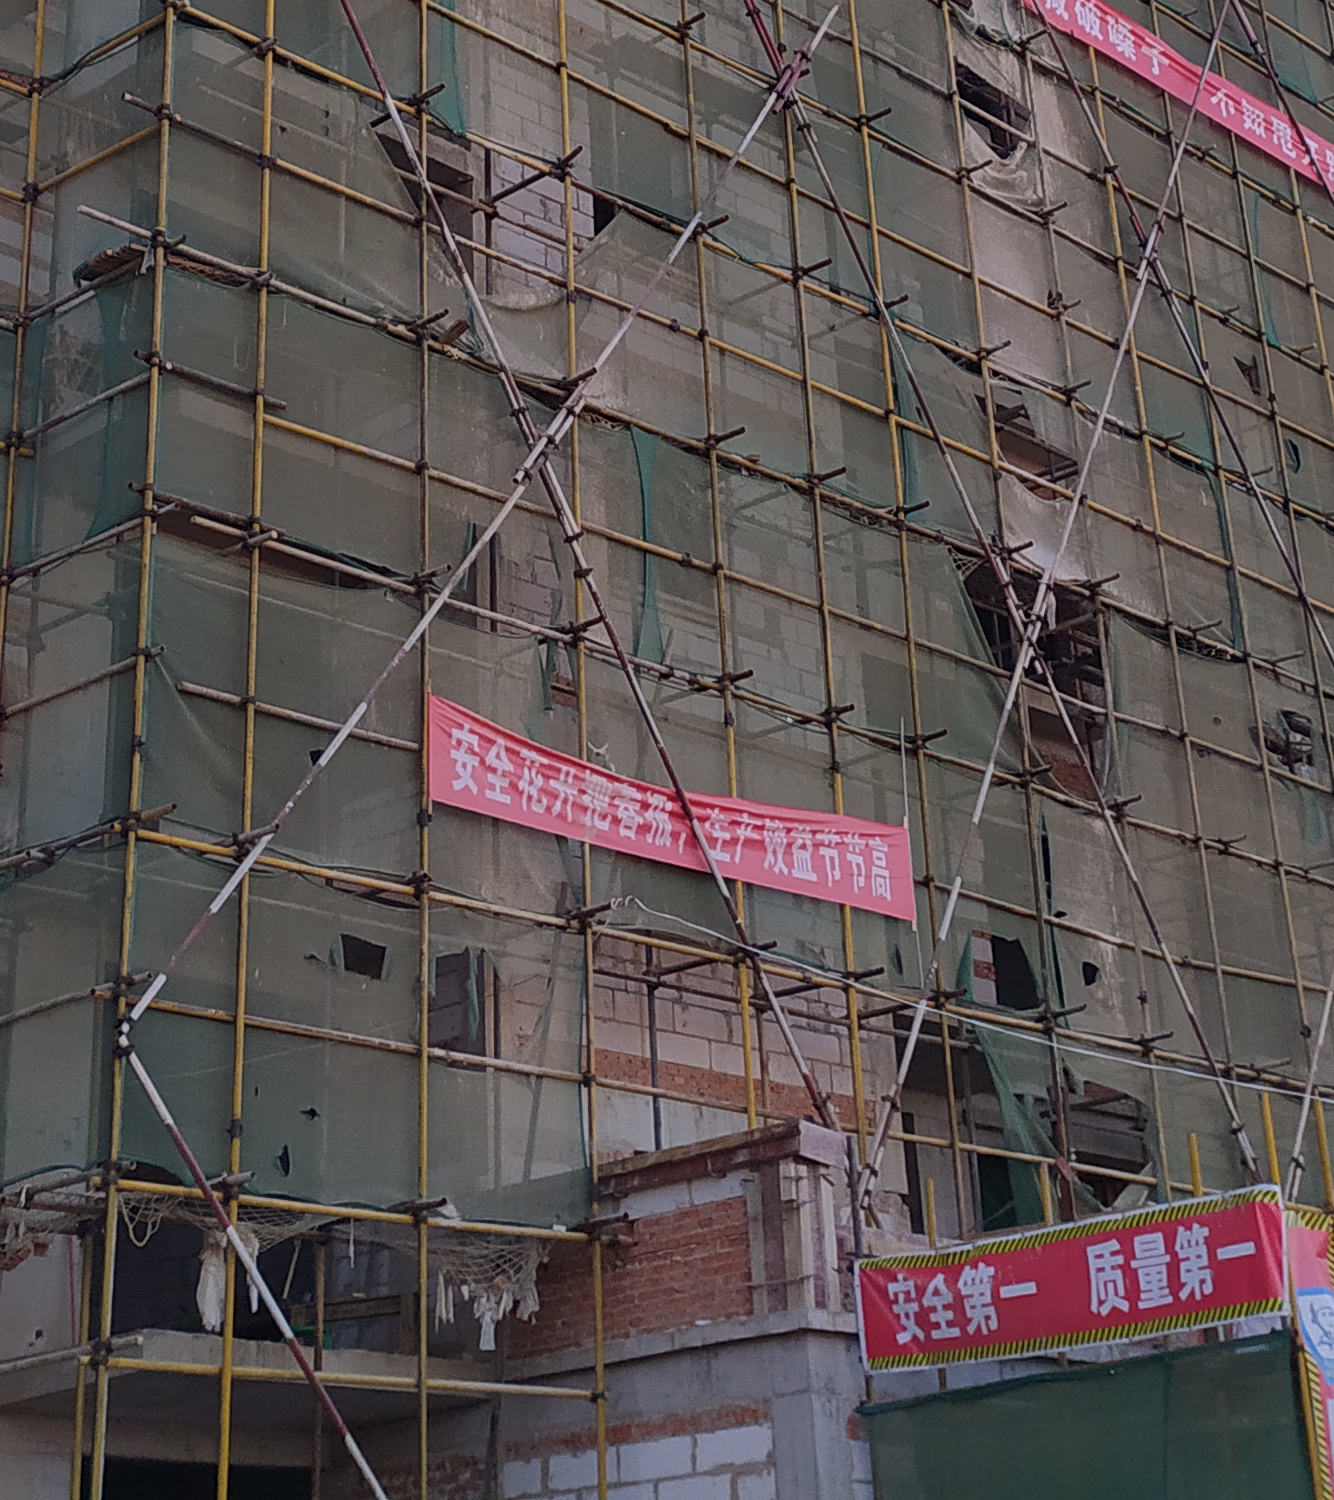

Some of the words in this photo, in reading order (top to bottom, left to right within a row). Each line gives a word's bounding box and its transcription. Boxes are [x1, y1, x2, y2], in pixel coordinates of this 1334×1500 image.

[887, 1263, 1037, 1344] 安全第一
[1088, 1224, 1257, 1317] 质量第一
